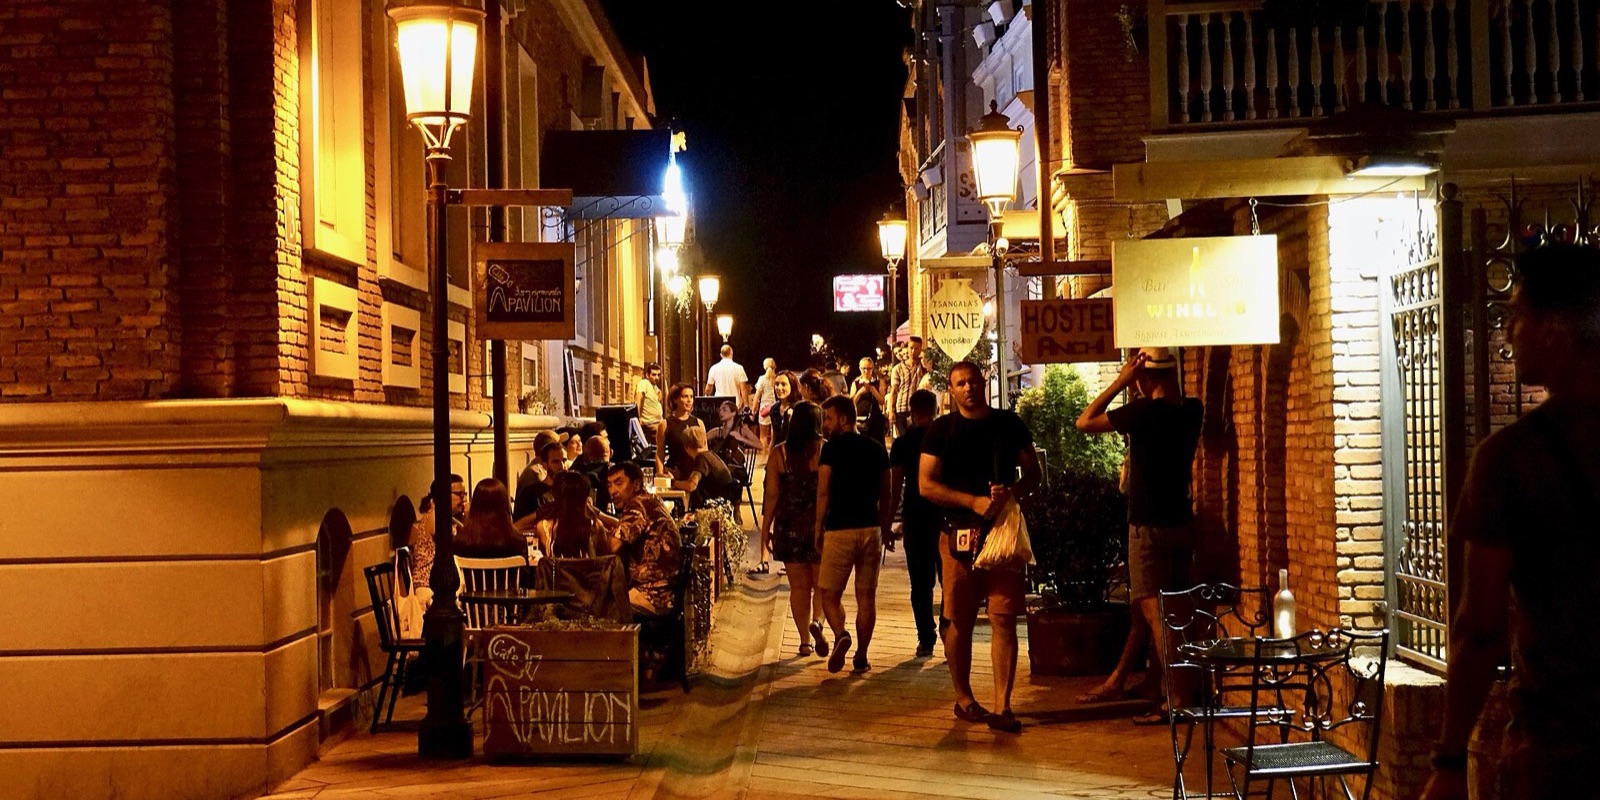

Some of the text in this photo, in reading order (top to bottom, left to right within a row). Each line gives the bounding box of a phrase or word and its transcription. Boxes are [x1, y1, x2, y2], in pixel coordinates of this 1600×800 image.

[1142, 279, 1170, 292] Bar
[933, 300, 979, 308] TSANGALA'S
[930, 312, 981, 330] WINE
[1024, 303, 1113, 334] HOSTEL
[1134, 329, 1167, 342] Biggest
[492, 639, 519, 666] Cafe
